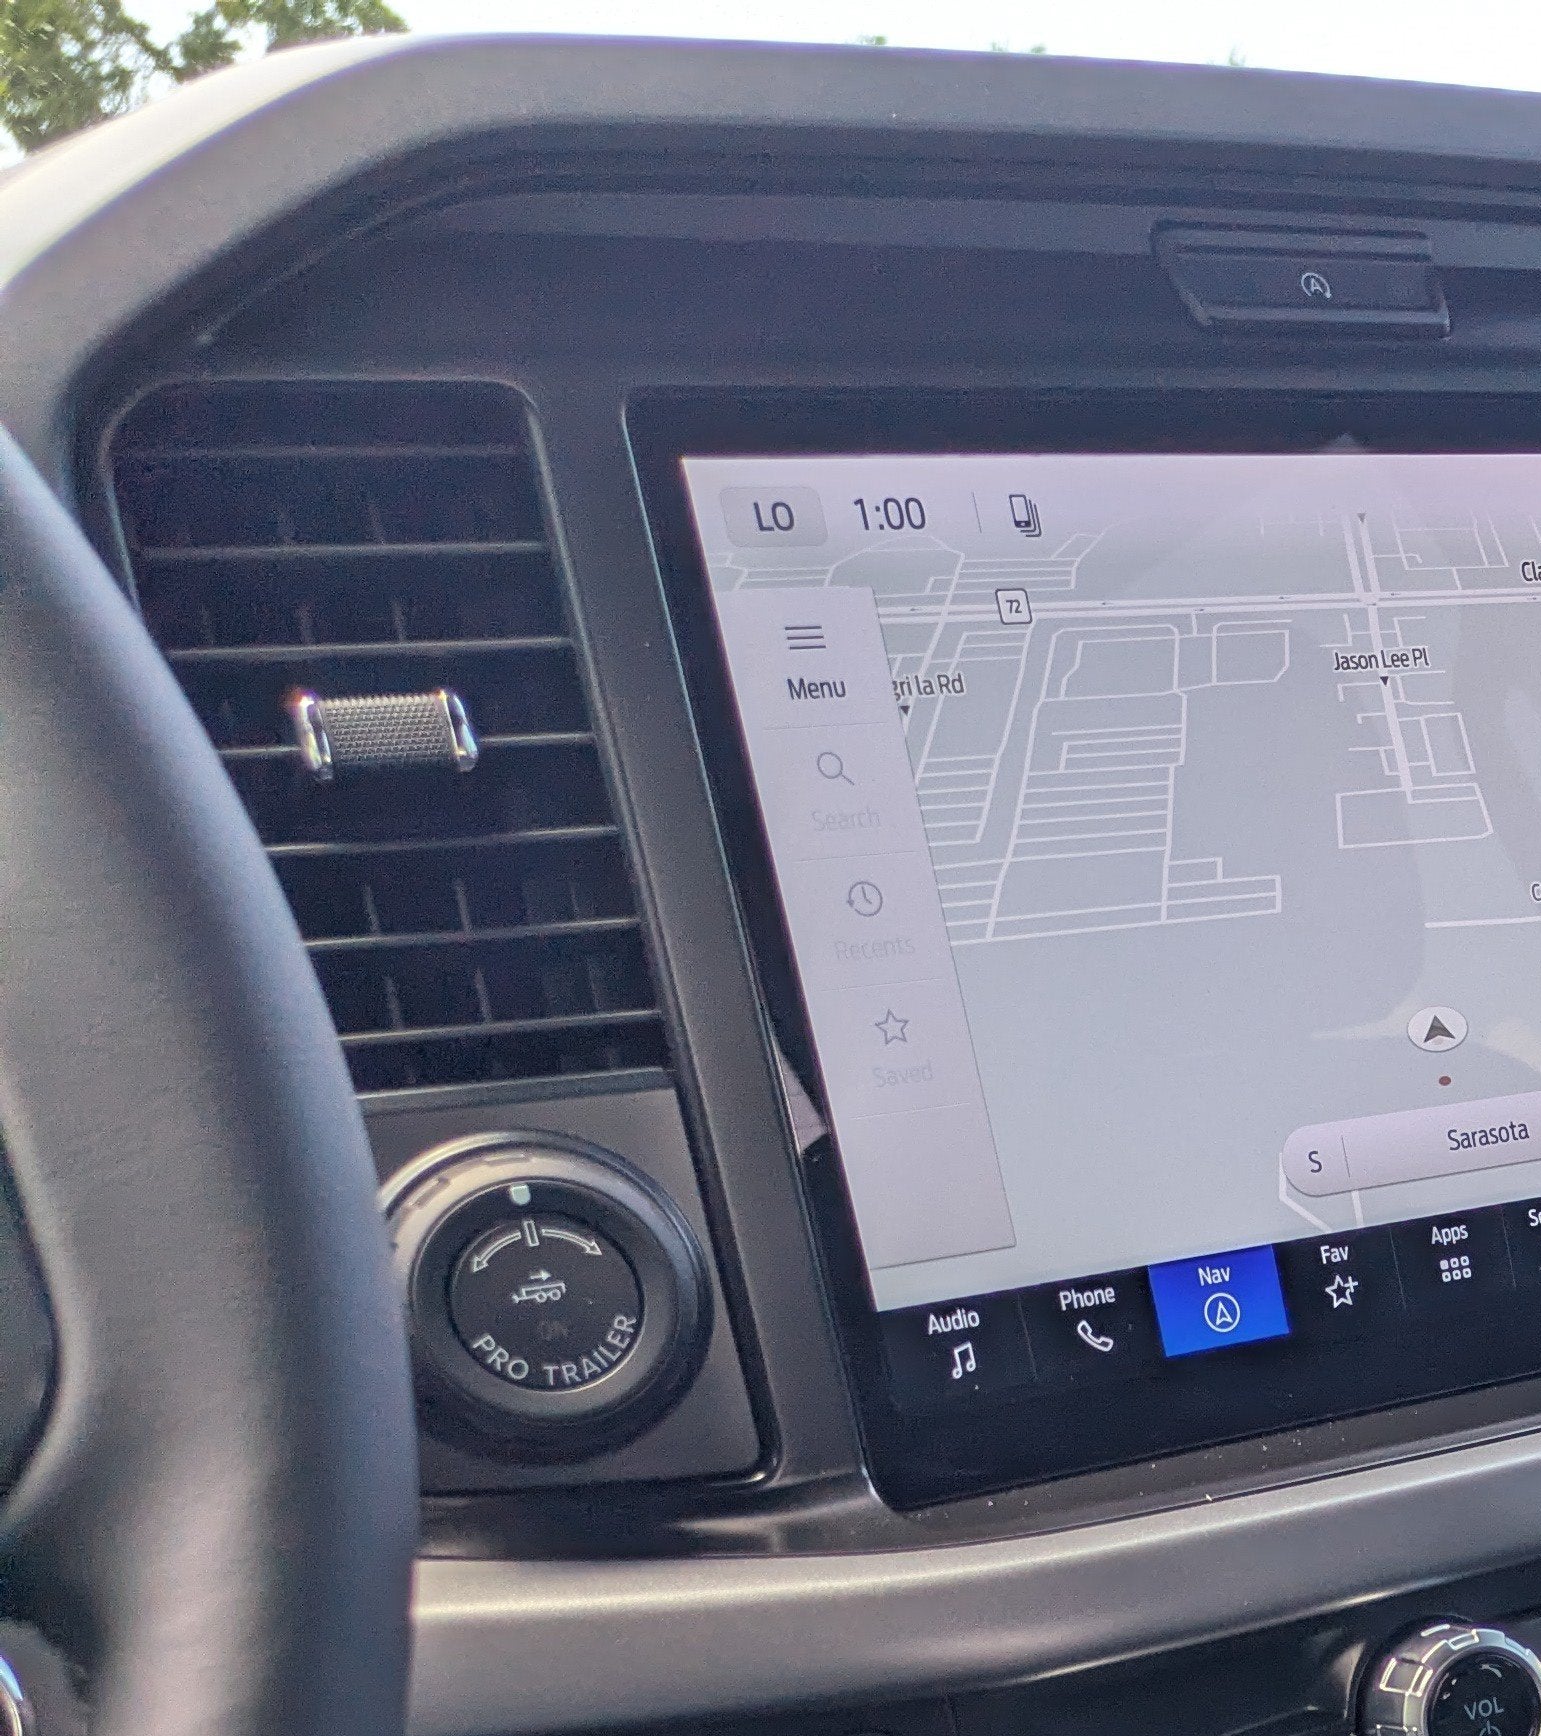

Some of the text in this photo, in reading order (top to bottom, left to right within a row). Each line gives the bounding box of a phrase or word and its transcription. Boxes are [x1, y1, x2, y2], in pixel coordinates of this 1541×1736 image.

[753, 502, 796, 533] LO
[852, 496, 927, 532] 1:00
[1005, 598, 1023, 616] 72
[1333, 646, 1429, 672] Jason Lee Pl
[786, 676, 847, 702] Menu
[937, 672, 965, 696] Rd
[811, 806, 882, 833] Search
[833, 936, 916, 963] Recents
[872, 1061, 934, 1088] Saved
[1447, 1120, 1530, 1151] Sarasota
[1307, 1150, 1323, 1175] S
[1431, 1223, 1469, 1246] Apps
[1320, 1243, 1350, 1264] Fav
[1197, 1266, 1231, 1287] Nav
[1058, 1284, 1116, 1311] Phone
[927, 1307, 981, 1336] Audio
[472, 1315, 638, 1386] PRO TRAILER
[1463, 1697, 1505, 1722] VOL
